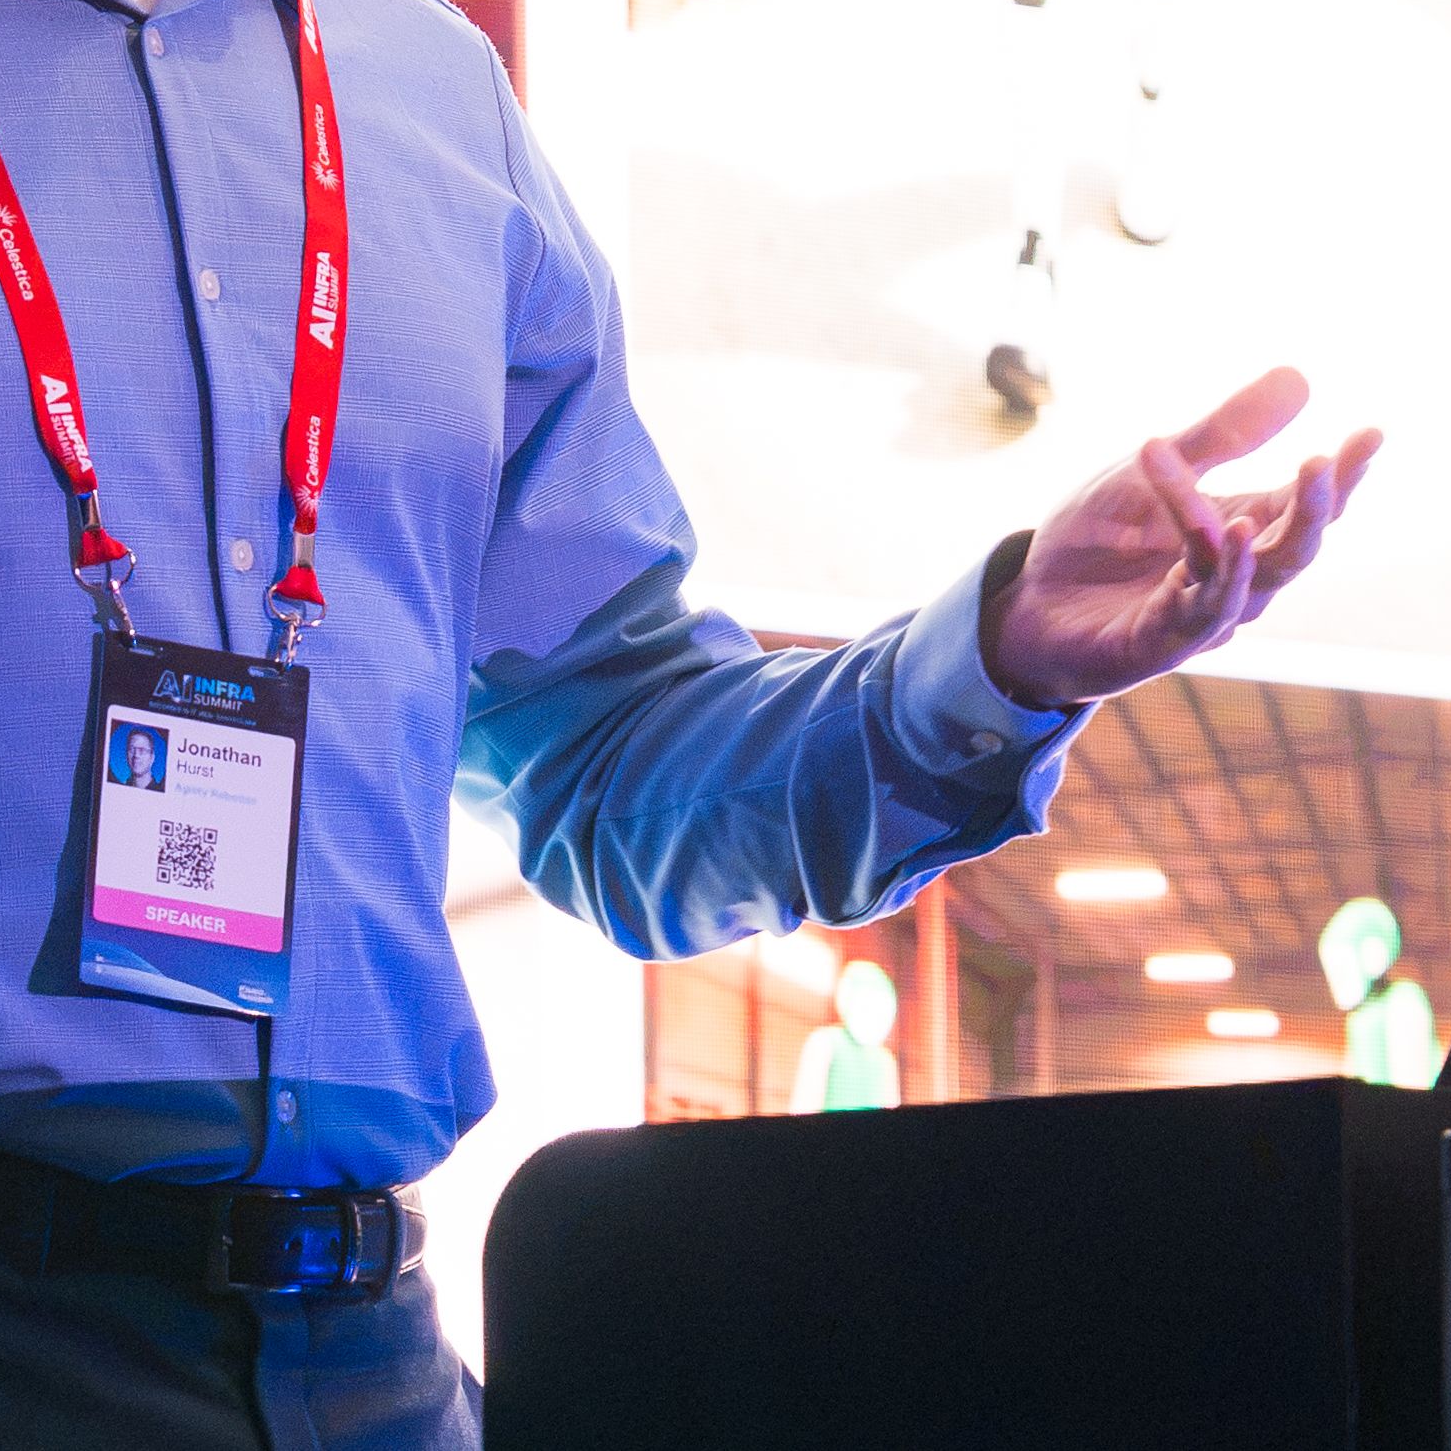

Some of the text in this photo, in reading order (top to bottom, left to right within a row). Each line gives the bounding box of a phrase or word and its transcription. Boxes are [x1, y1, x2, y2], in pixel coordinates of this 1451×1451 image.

[315, 103, 330, 165] Celestica
[309, 251, 337, 350] AI INFRA
[328, 263, 340, 312] SUMMIT
[40, 374, 94, 474] AI INFRA
[50, 415, 76, 463] SUMMIT
[305, 415, 321, 486] Celestica
[152, 668, 256, 703] AI INFRA
[193, 692, 243, 711] SUMMIT
[176, 759, 215, 779] Hurst
[177, 737, 262, 768] Jonathan
[144, 905, 228, 934] SPEAKER
